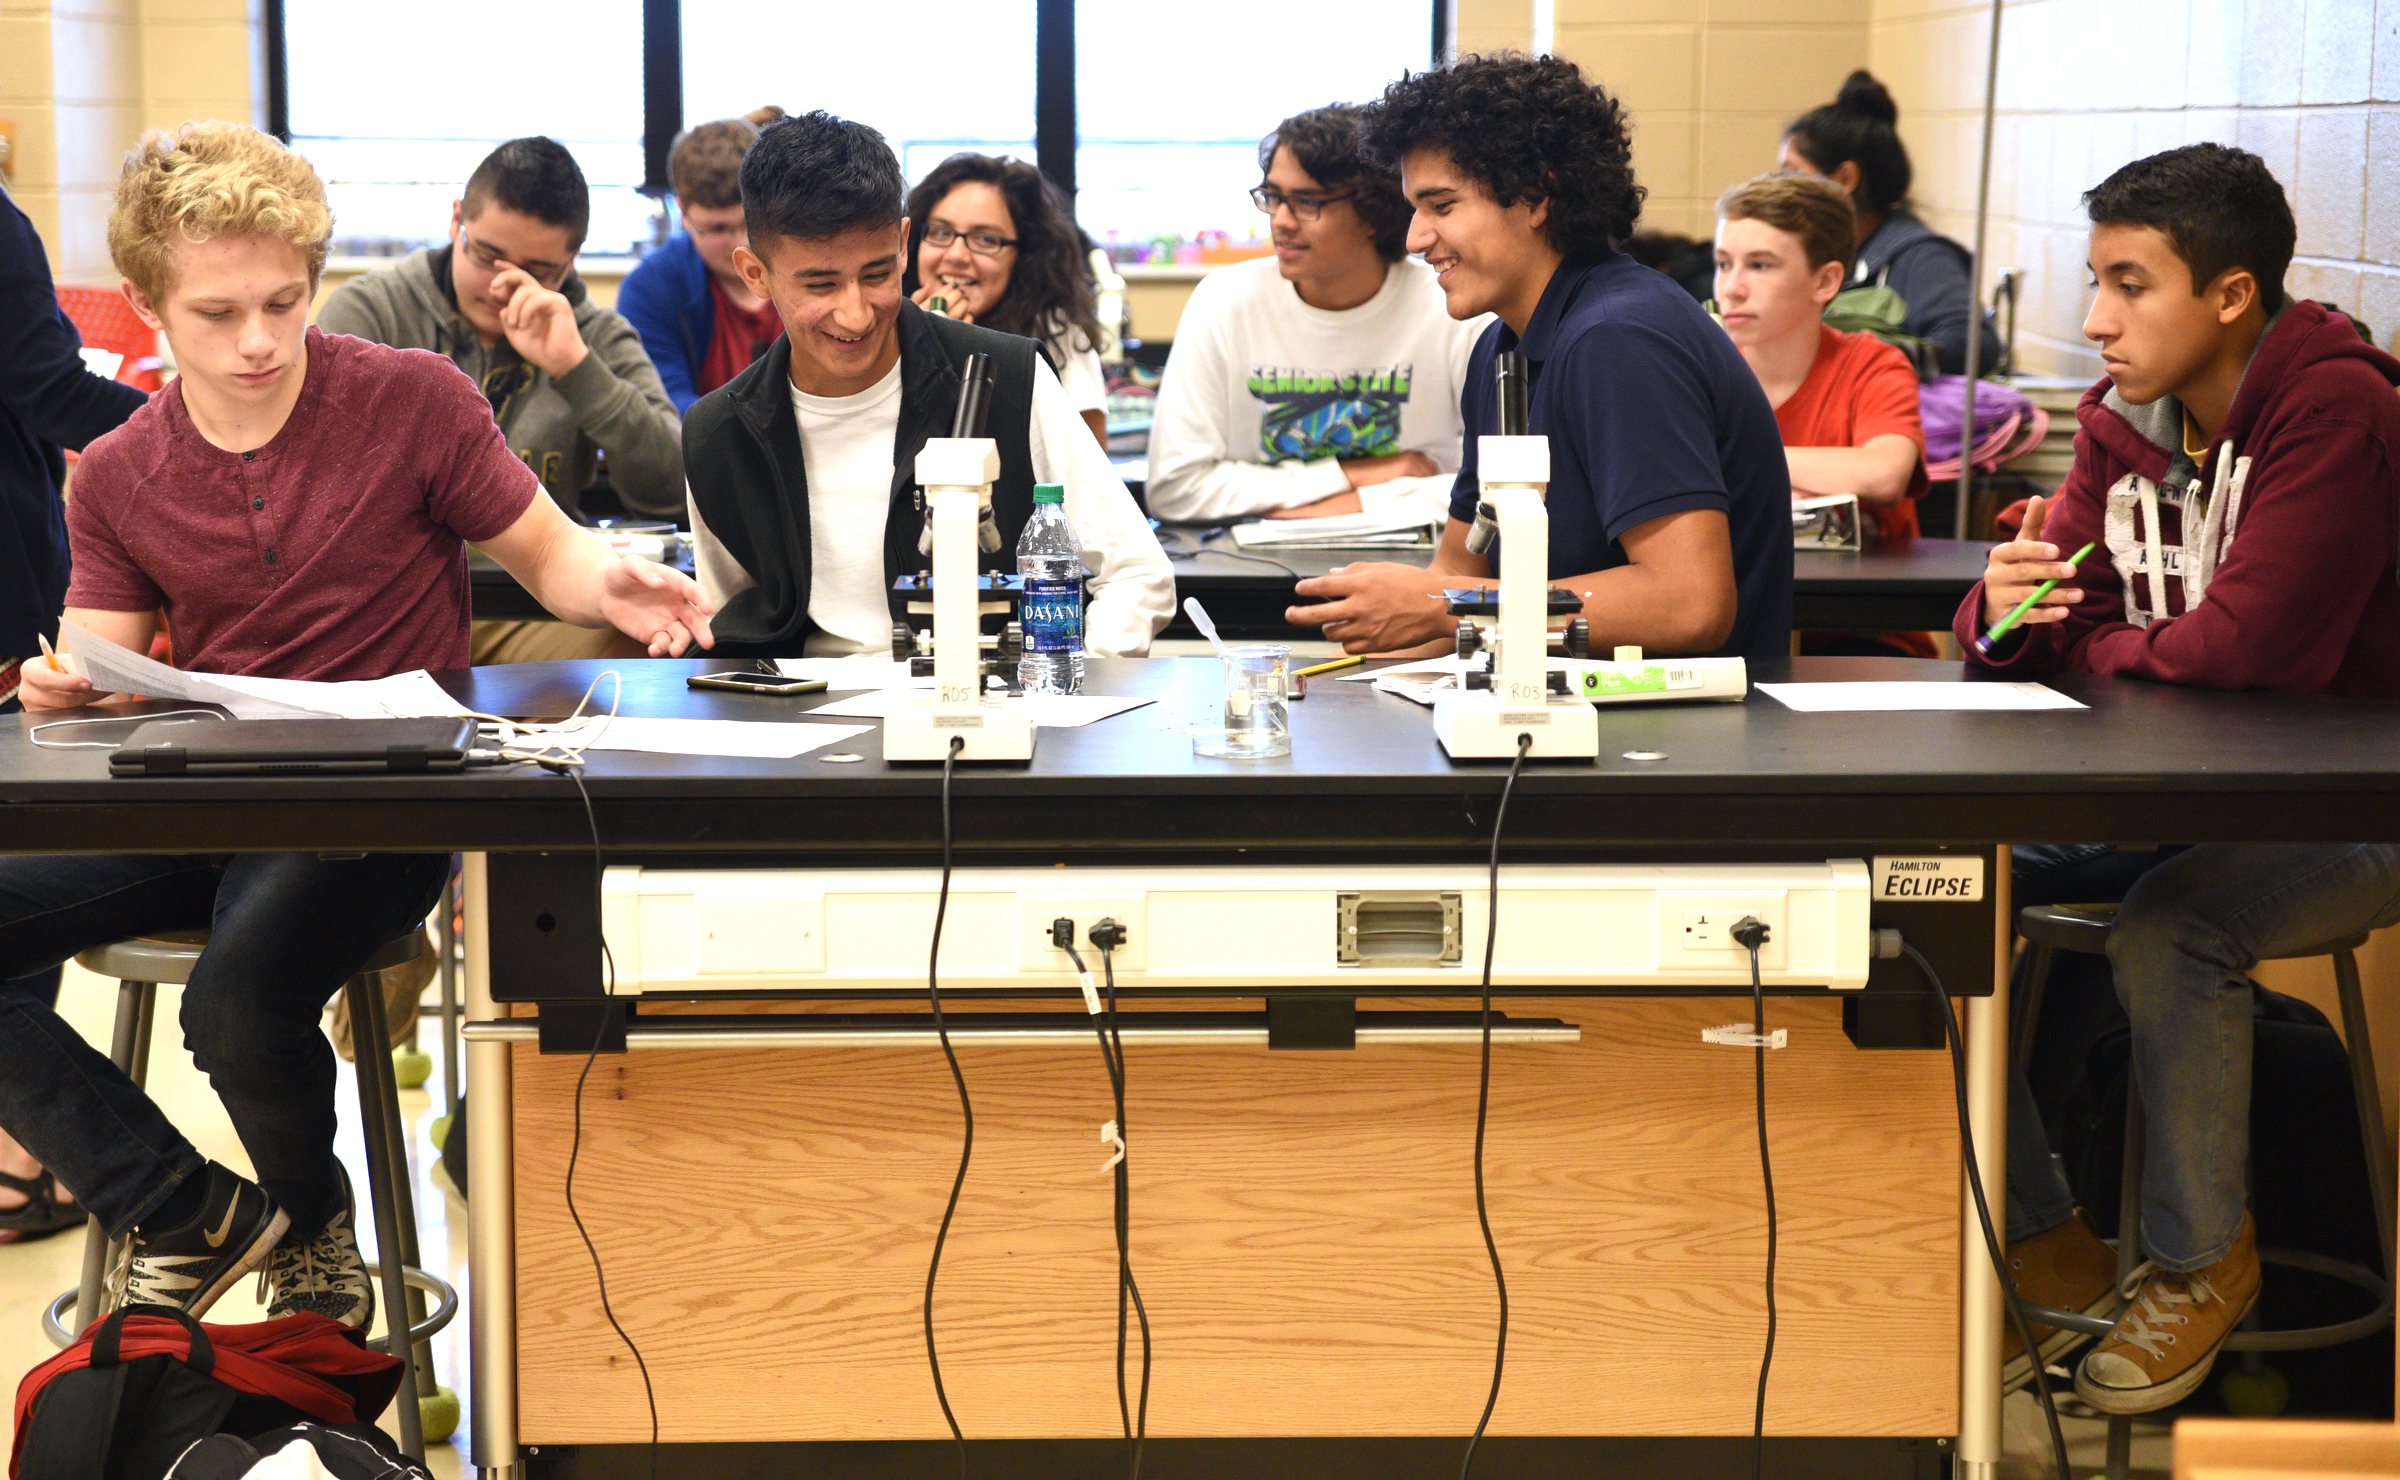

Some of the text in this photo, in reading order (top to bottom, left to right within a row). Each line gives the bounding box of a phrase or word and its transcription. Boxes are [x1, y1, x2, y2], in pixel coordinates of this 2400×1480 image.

[1025, 602, 1079, 624] DASANI
[1602, 679, 1621, 687] Plus
[1889, 860, 1941, 871] HAMILTON
[1884, 874, 1973, 896] ECLIPSE
